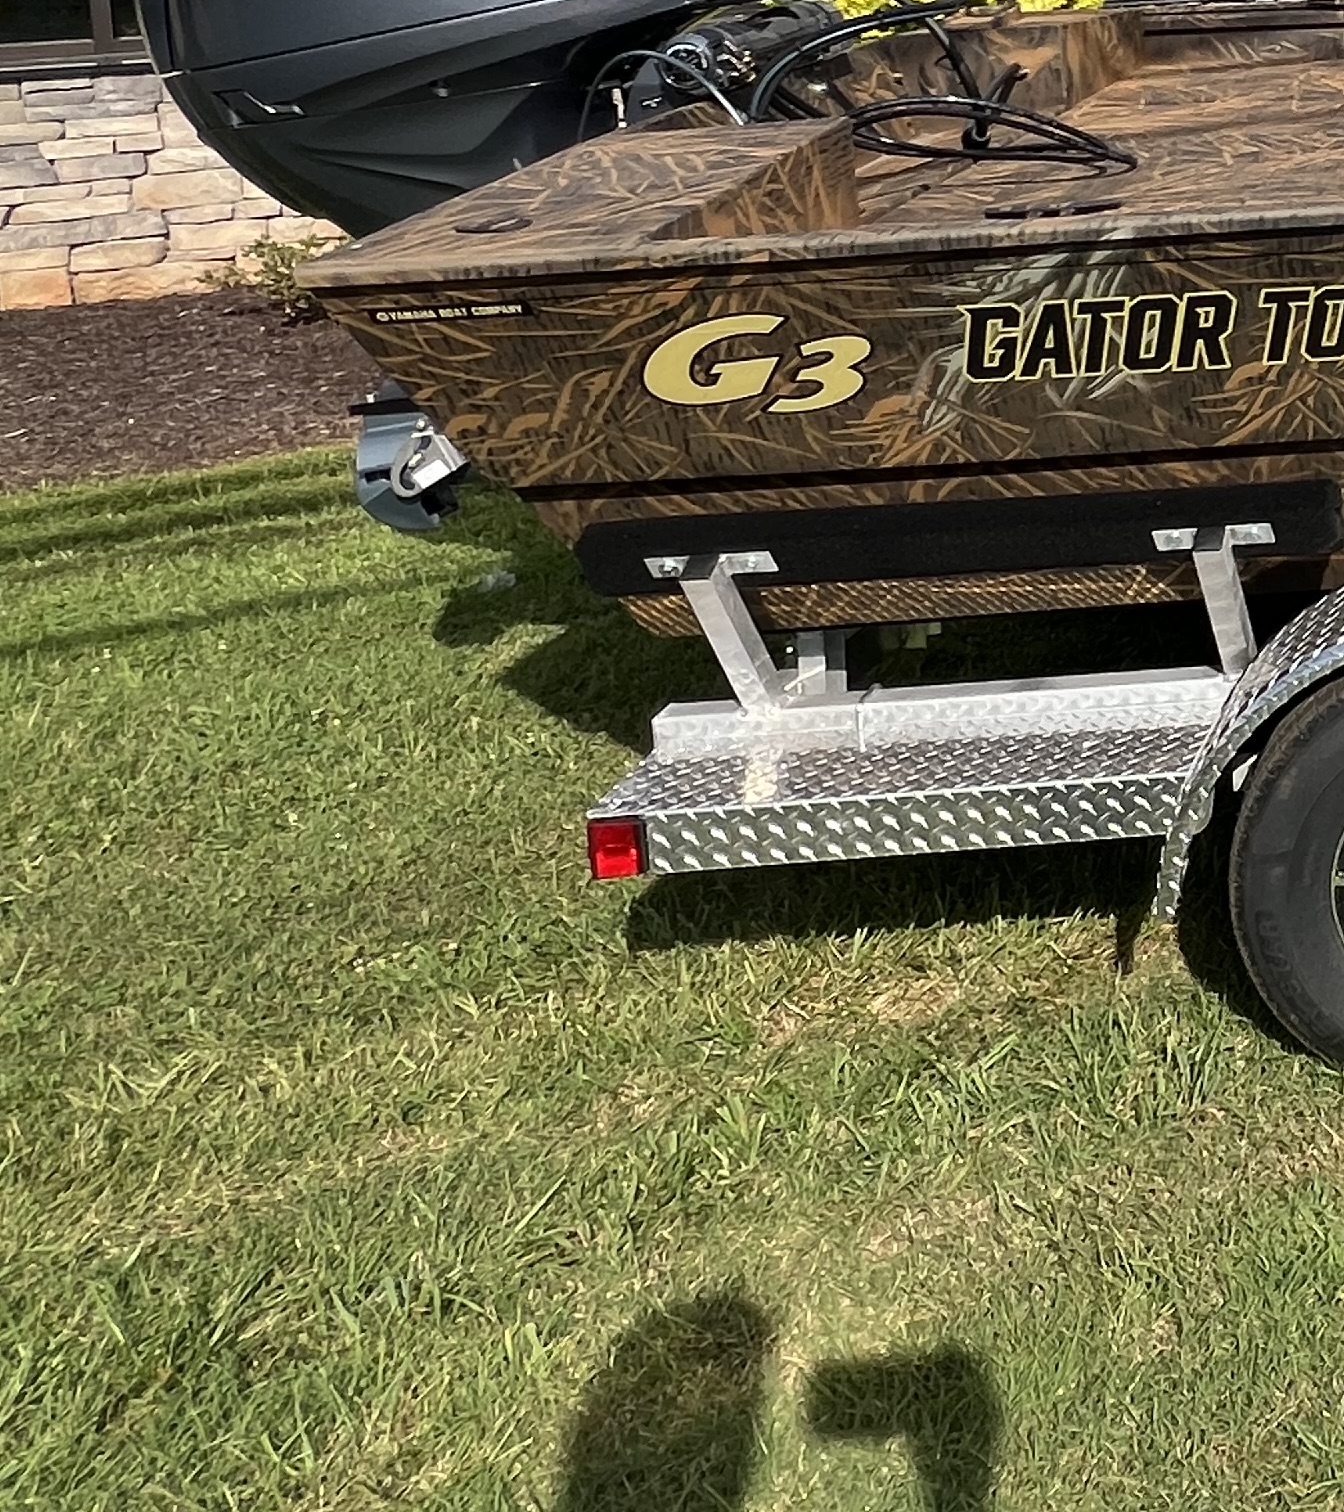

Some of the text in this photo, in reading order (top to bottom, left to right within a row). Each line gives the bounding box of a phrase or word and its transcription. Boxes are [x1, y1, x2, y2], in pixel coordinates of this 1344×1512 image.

[389, 309, 437, 321] YAMAHA
[957, 290, 1238, 383] GATOR
[641, 313, 873, 414] G3
